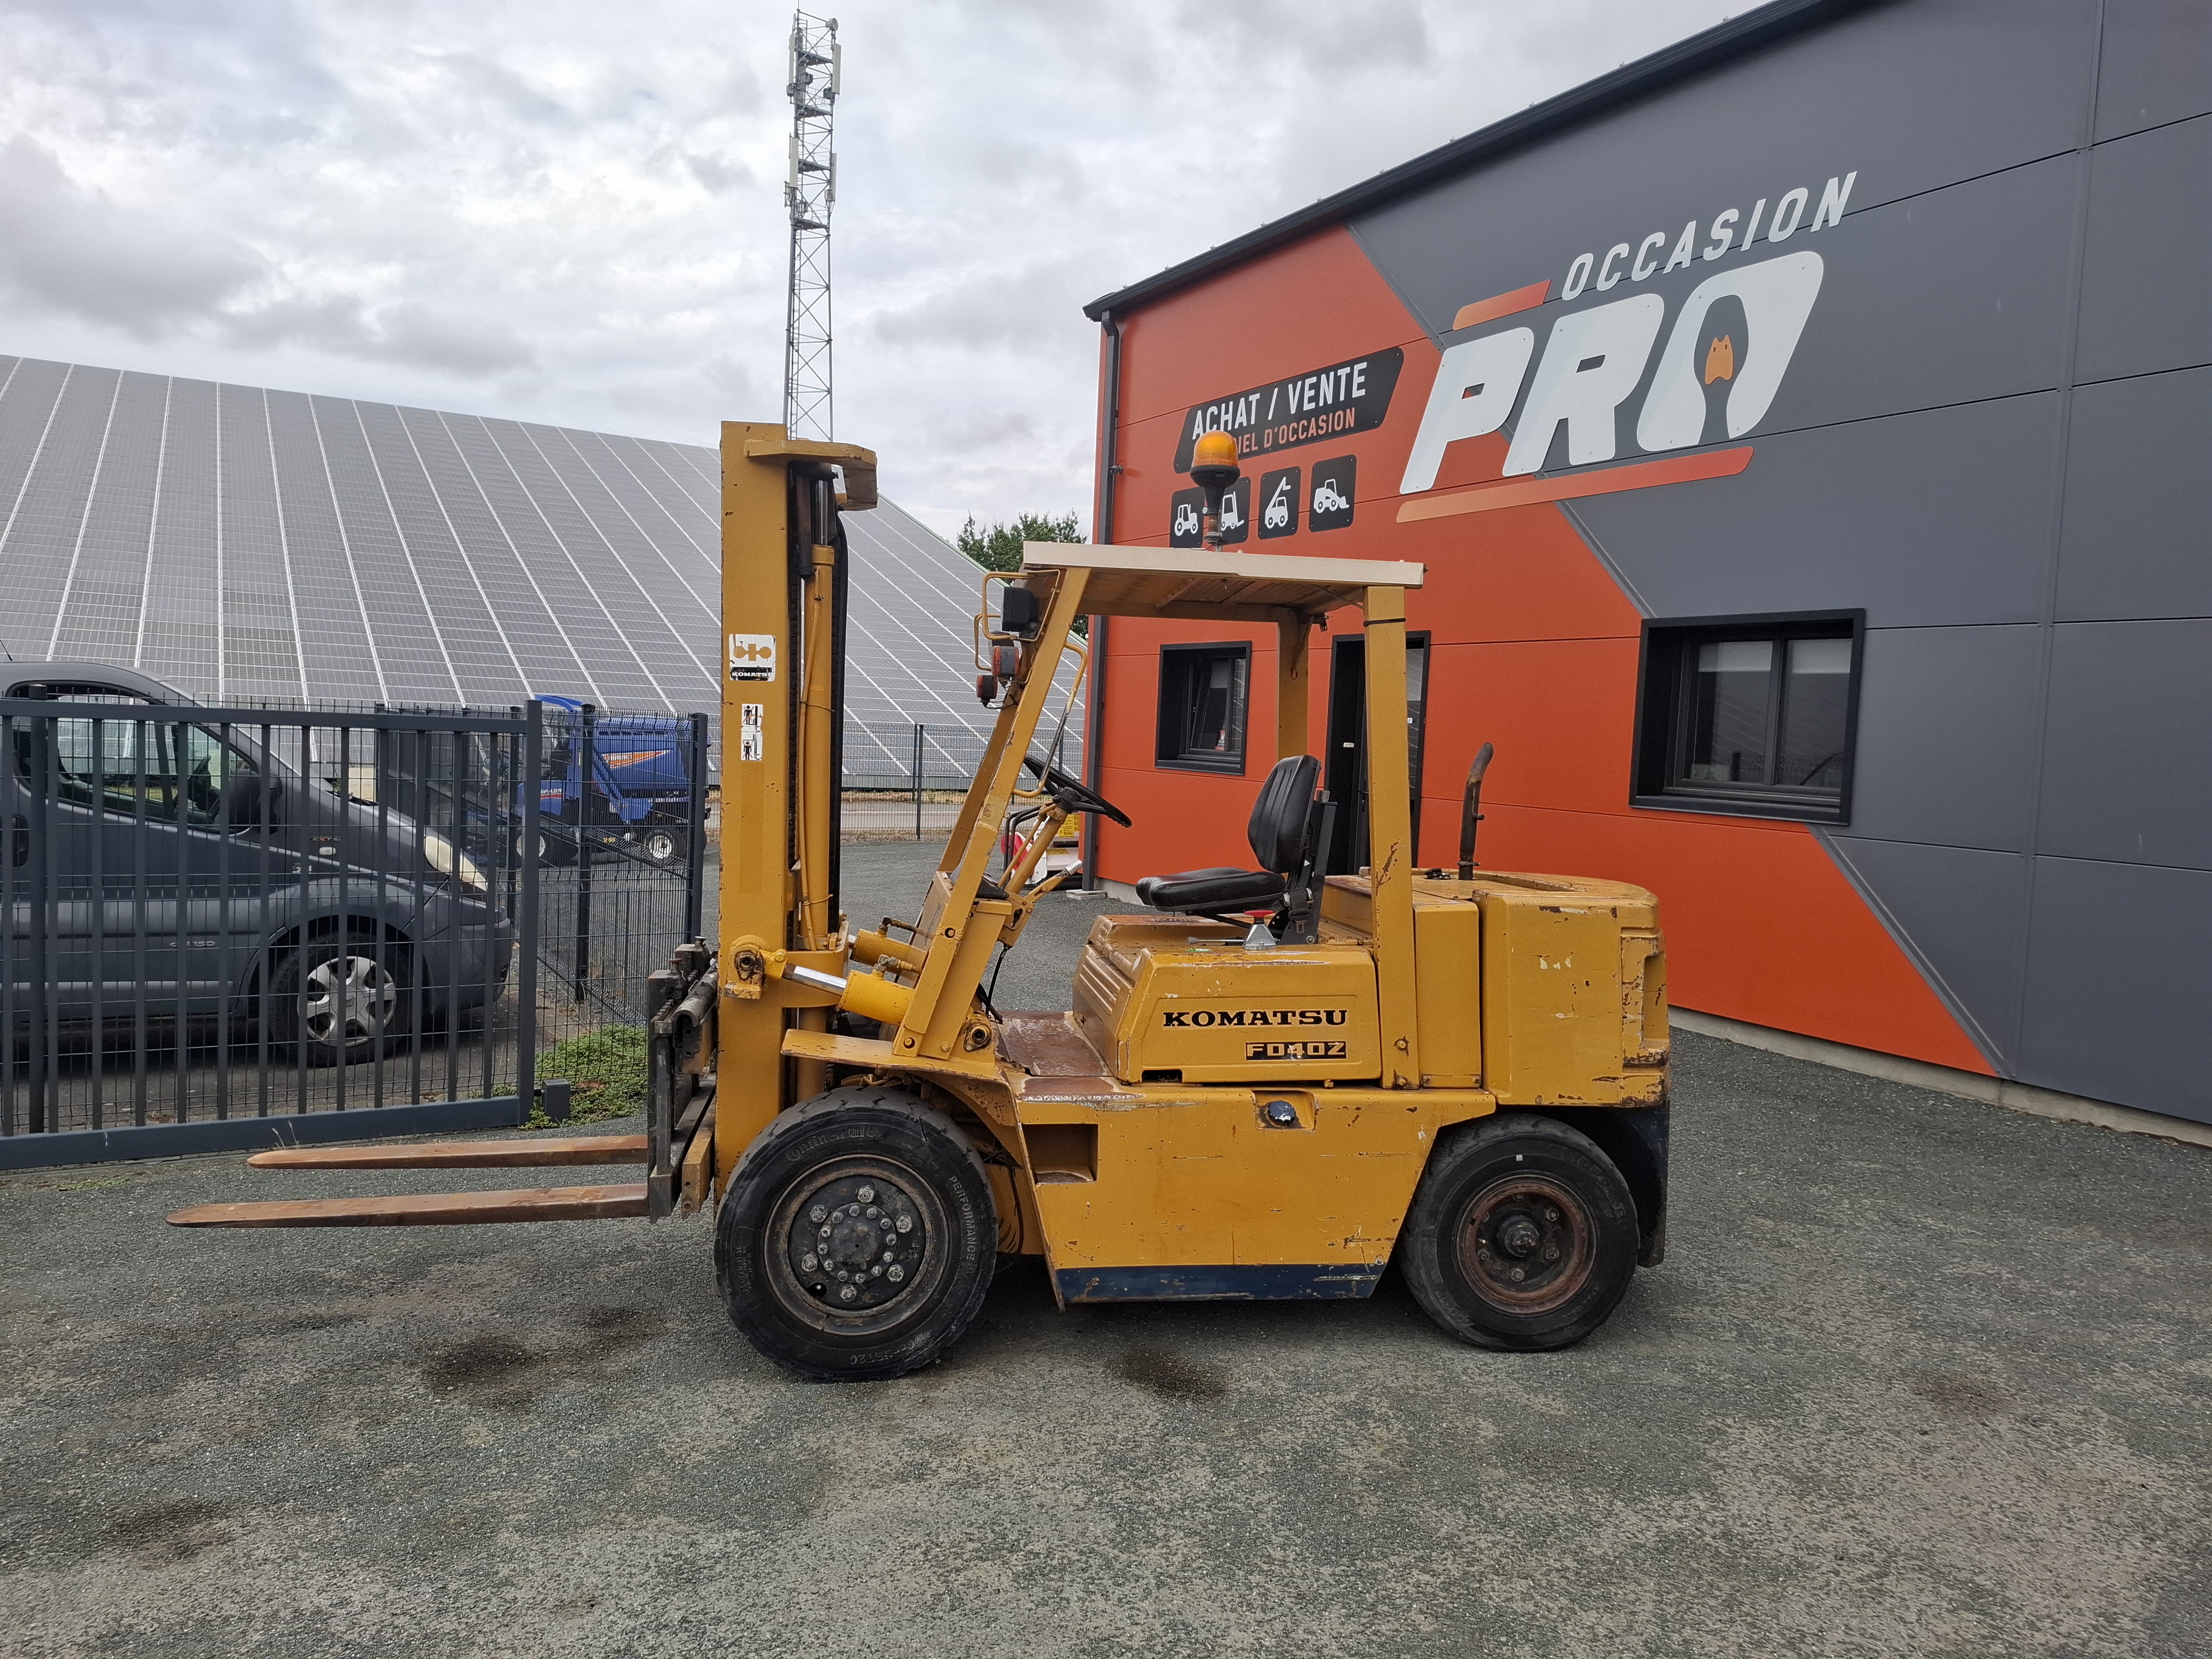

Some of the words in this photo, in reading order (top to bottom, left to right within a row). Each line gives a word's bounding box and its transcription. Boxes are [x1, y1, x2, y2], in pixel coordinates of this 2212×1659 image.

[1561, 171, 1857, 300] OCCASION
[1192, 393, 1260, 440] ACHAT
[1268, 388, 1278, 420] /
[1288, 362, 1367, 414] VENTE
[1400, 251, 1824, 494] PRO
[1264, 407, 1355, 448] D'OCCASION
[1163, 1009, 1347, 1027] KOMATSU
[1246, 1042, 1345, 1057] FD40Z
[948, 1175, 977, 1261] PERFORMANCE
